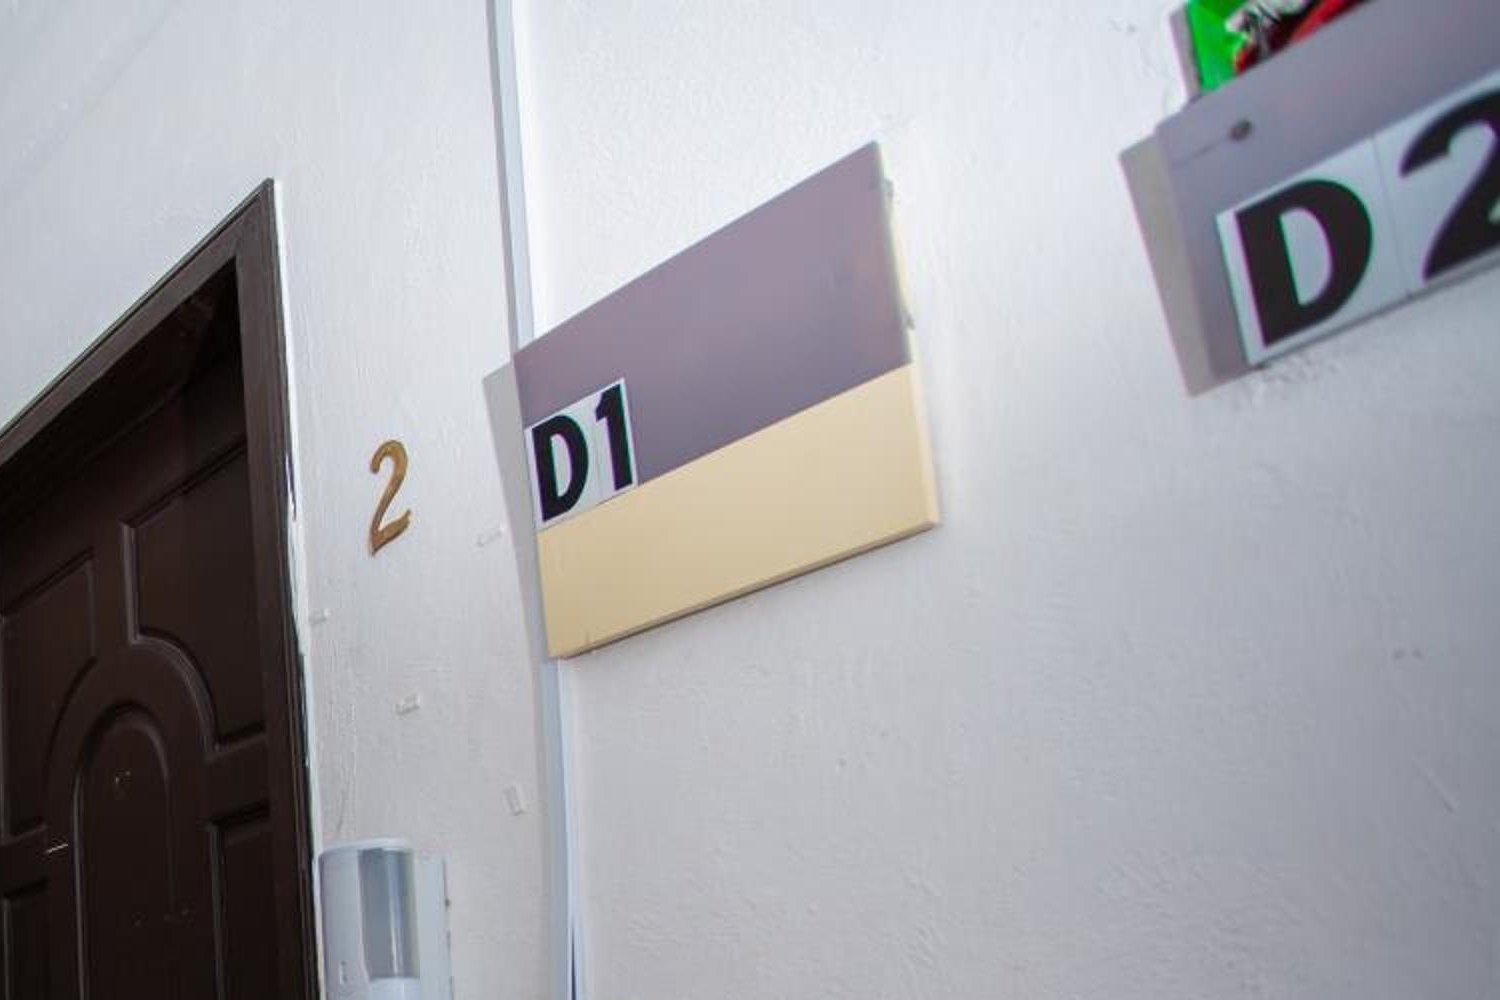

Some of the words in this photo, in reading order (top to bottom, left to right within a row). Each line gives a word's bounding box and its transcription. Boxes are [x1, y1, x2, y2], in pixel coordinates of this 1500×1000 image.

[1235, 89, 1500, 348] D2
[369, 439, 412, 556] 2
[532, 383, 634, 523] D1
